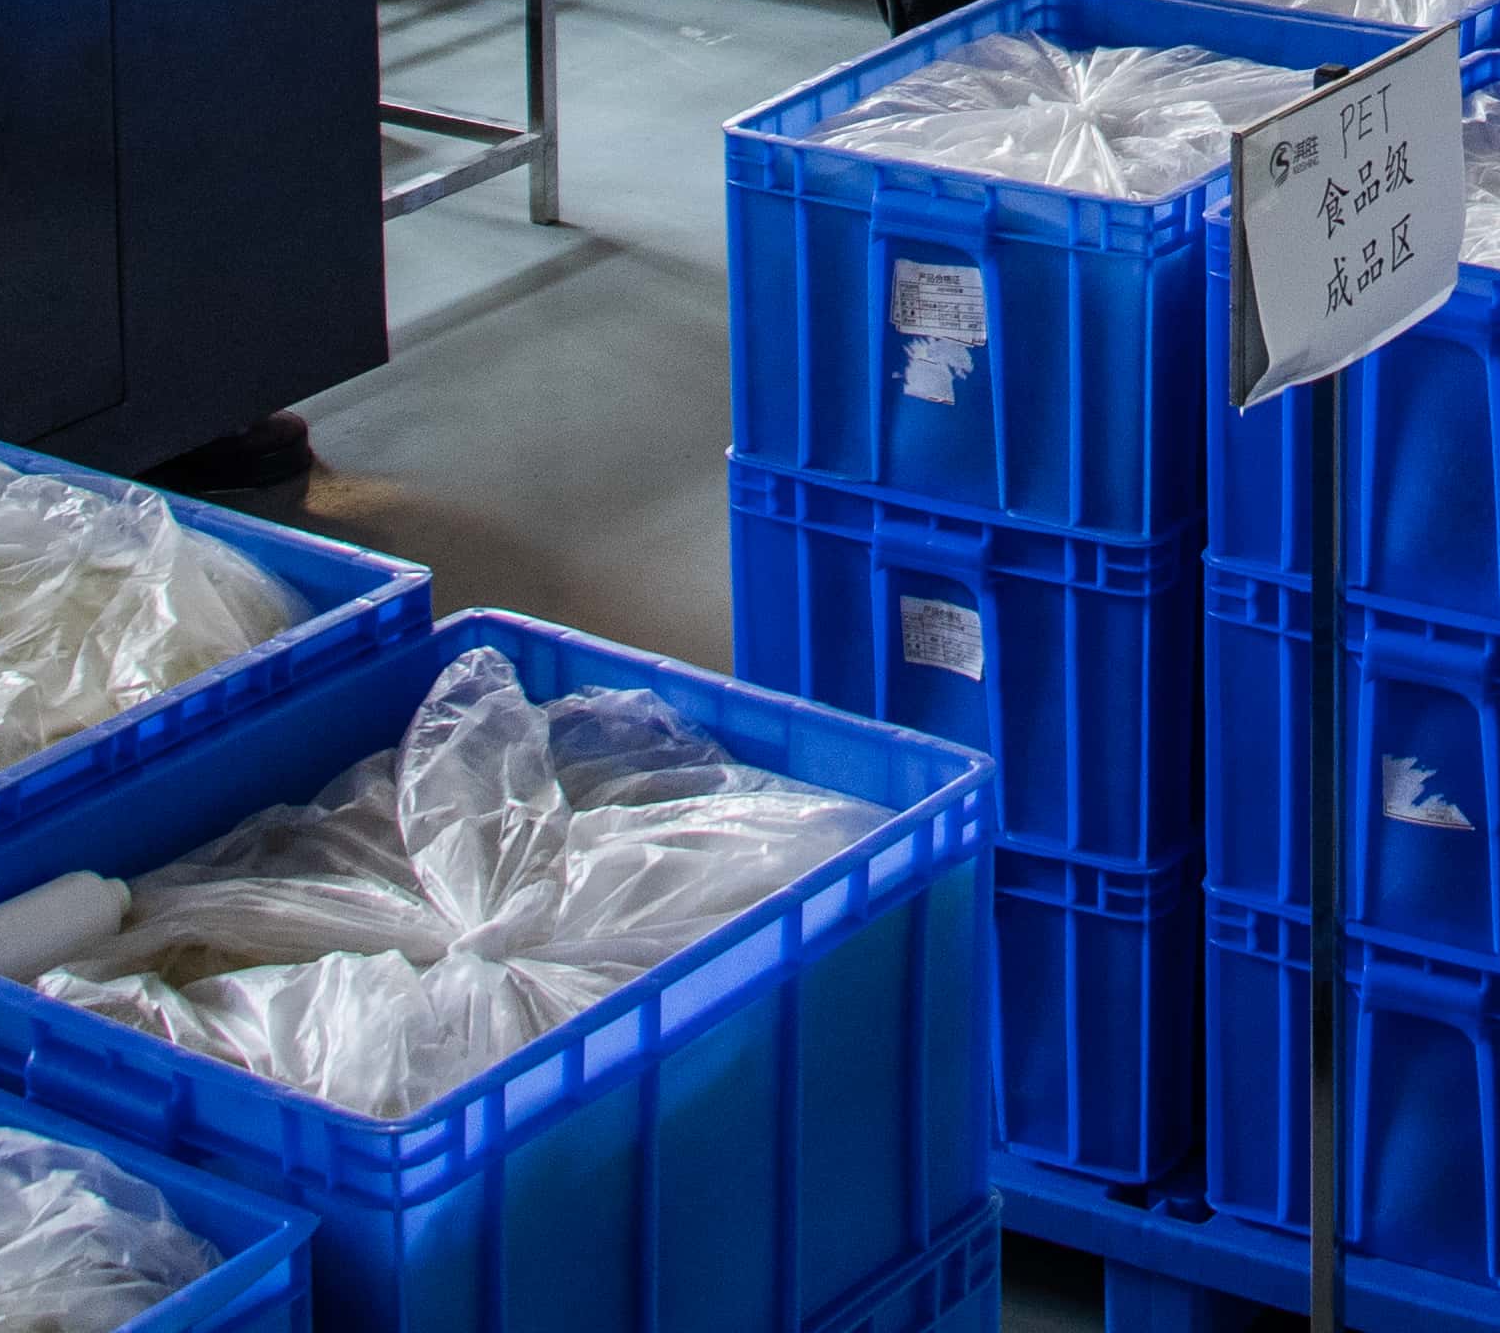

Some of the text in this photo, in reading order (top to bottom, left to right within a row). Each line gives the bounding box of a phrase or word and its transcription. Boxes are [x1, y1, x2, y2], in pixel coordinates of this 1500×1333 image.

[1340, 83, 1392, 159] PET
[1317, 141, 1415, 240] 食品级
[1325, 213, 1415, 318] 成品区
